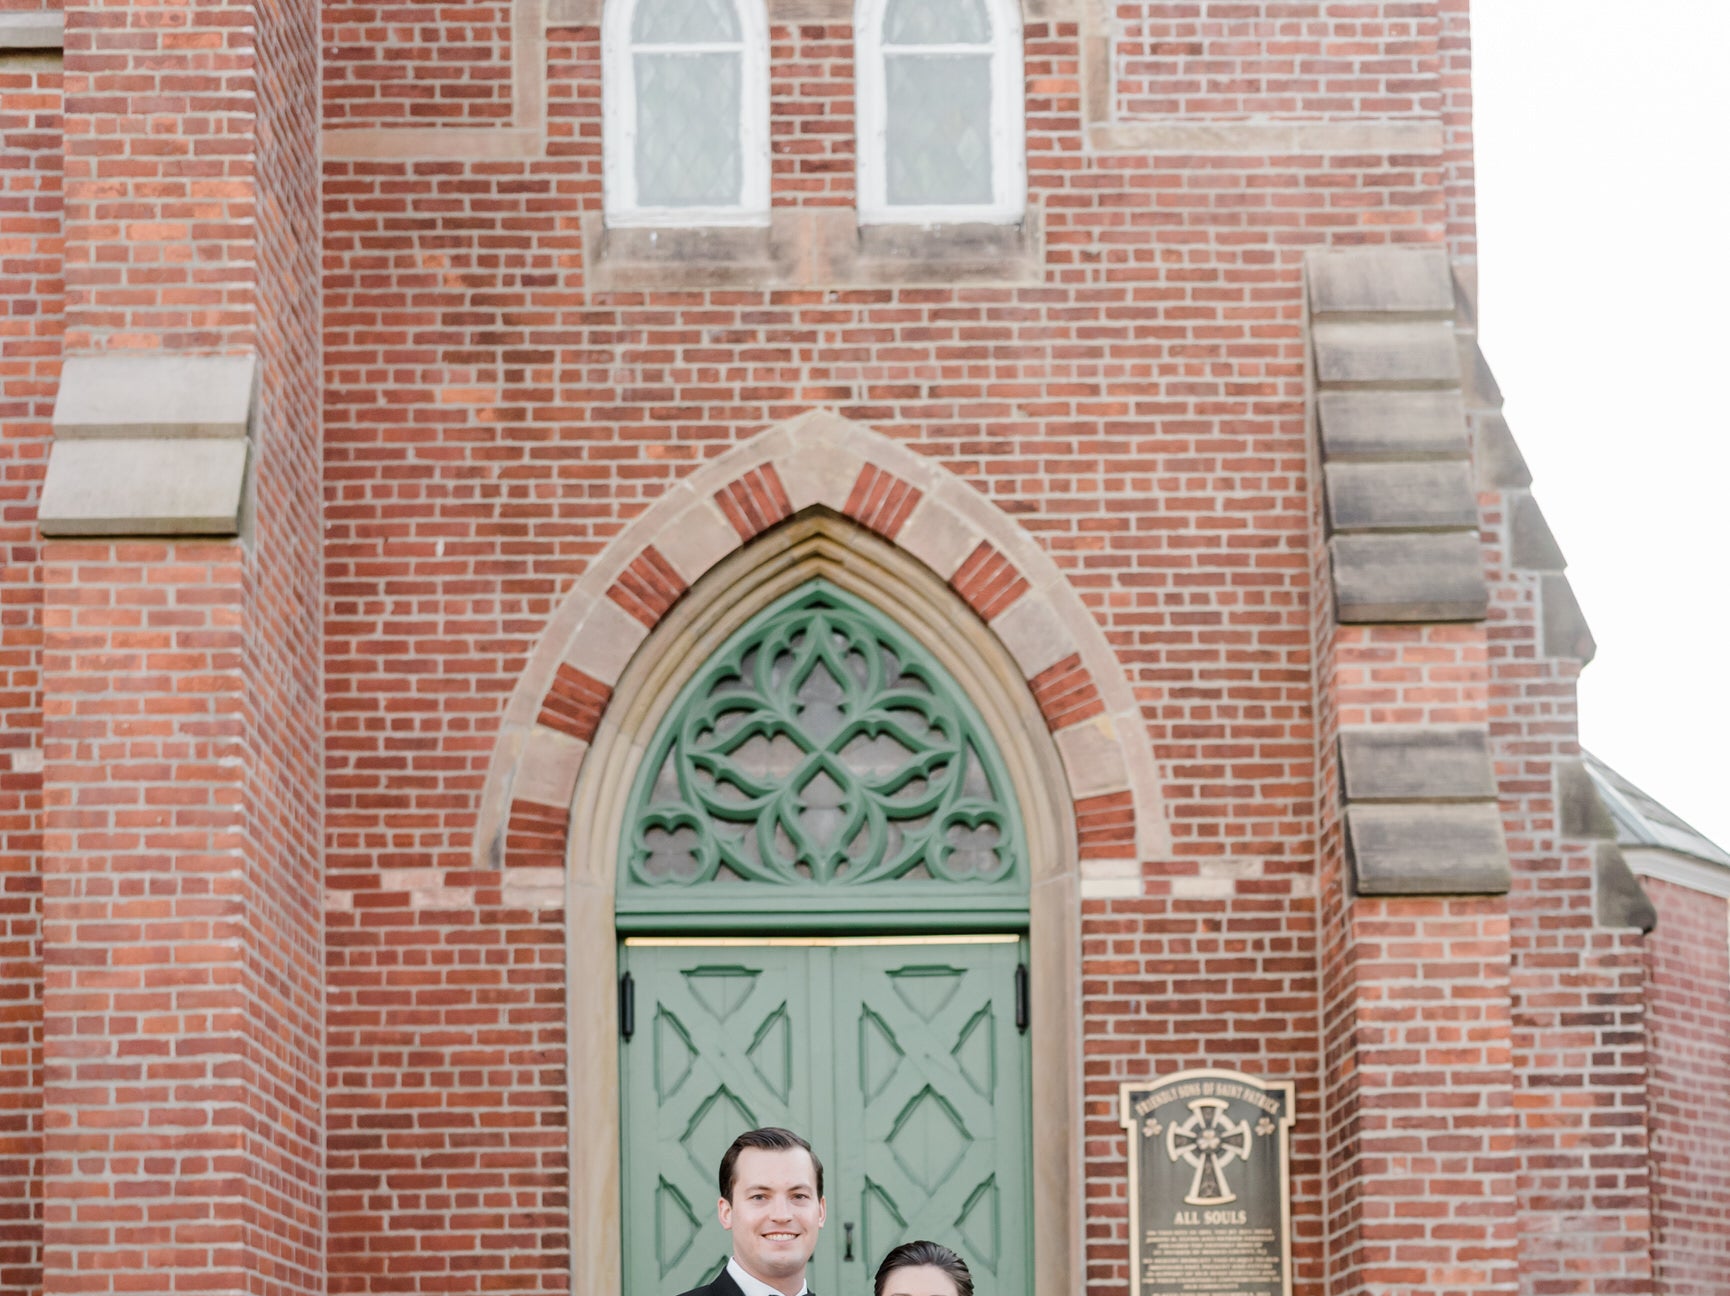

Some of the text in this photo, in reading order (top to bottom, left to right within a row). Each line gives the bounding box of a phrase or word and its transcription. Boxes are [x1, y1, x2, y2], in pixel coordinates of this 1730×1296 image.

[1135, 1081, 1280, 1116] FRIENDLY SONS OF SAINT PATRICK
[1174, 1210, 1247, 1225] ALL SOULS
